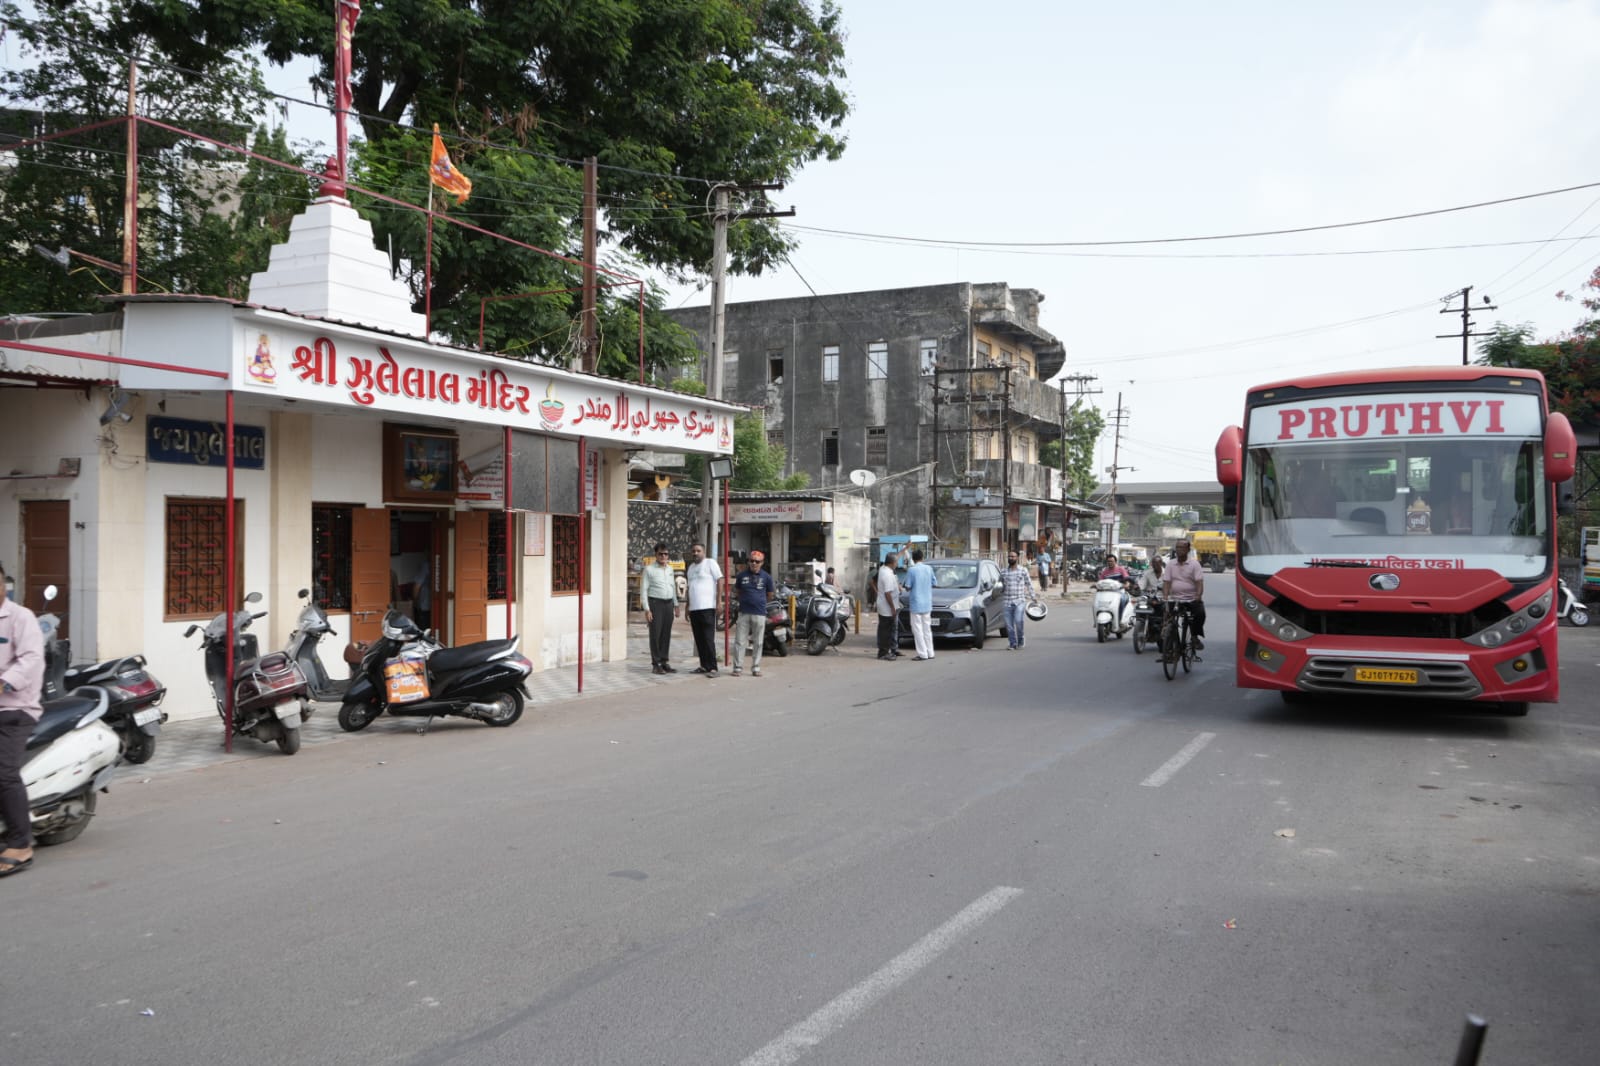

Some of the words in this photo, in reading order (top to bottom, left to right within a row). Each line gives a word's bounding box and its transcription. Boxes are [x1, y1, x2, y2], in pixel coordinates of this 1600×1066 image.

[292, 337, 337, 386] શ્રી
[347, 347, 460, 405] ઝુલેલાલ
[467, 369, 530, 413] મંદિર
[1277, 400, 1505, 440] PRUTHVI
